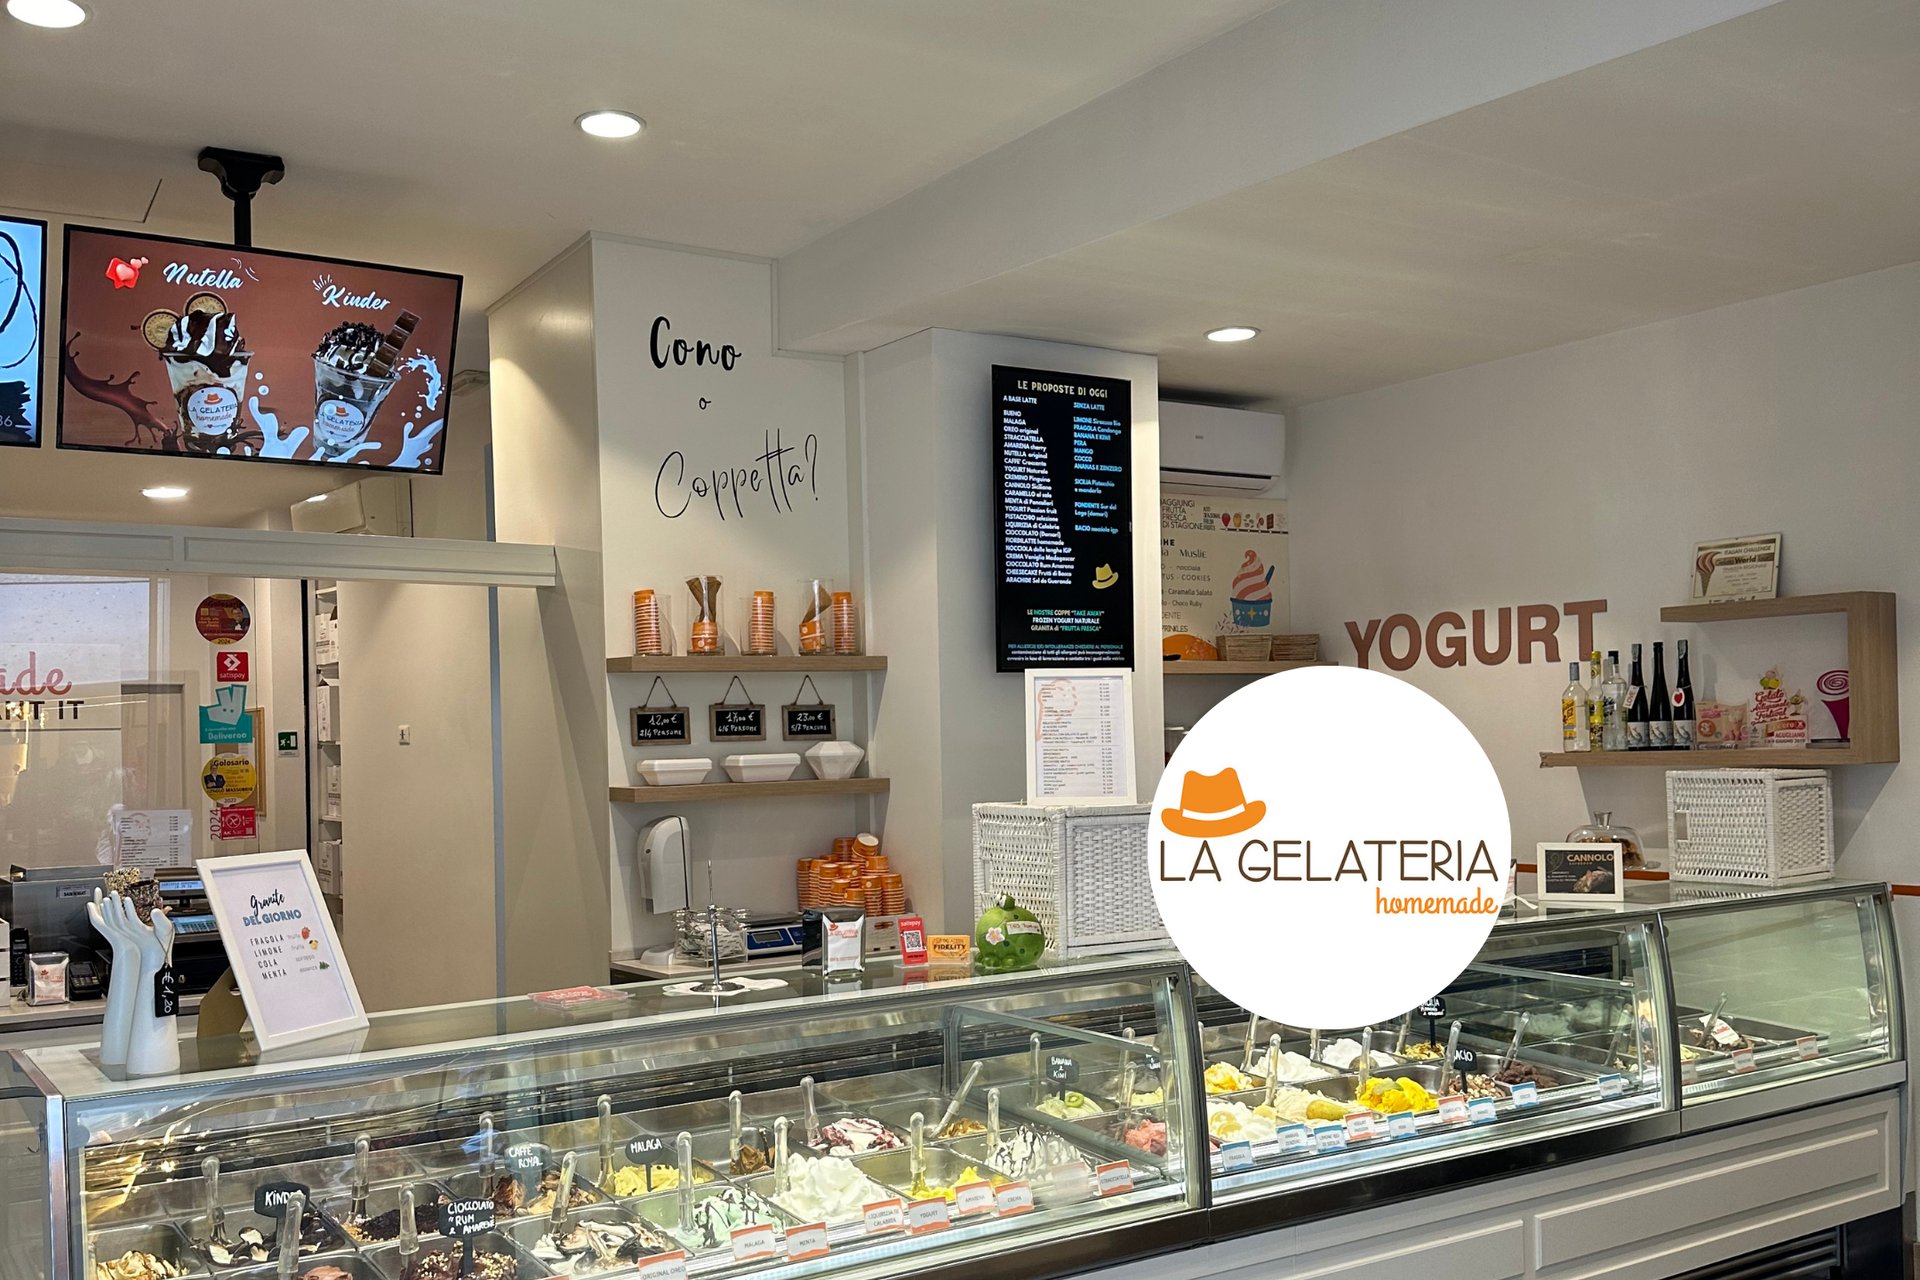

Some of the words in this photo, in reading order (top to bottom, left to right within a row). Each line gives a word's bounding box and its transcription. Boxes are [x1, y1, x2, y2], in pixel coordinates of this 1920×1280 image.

[163, 262, 244, 290] Nutella
[322, 284, 390, 310] Kinder
[650, 316, 742, 371] Cono
[1018, 380, 1028, 390] LE
[1031, 382, 1074, 394] PROPOSTE
[1078, 387, 1086, 396] DI
[1090, 388, 1108, 398] OGGI
[699, 397, 712, 410] o
[1004, 434, 1044, 443] STRACCIATELLA
[655, 428, 818, 520] Coppetta?
[1162, 506, 1186, 514] FRUTTA
[1162, 513, 1187, 521] FRESCA
[1170, 521, 1203, 530] STAGIONE
[1735, 556, 1756, 564] World
[1344, 599, 1607, 672] YOGURT
[1626, 690, 1636, 707] LOVE
[1755, 689, 1784, 701] Gelato
[670, 713, 678, 723] €
[748, 712, 755, 721] €
[817, 712, 824, 720] €
[1755, 708, 1787, 720] Festival
[208, 732, 247, 740] Deliveroo
[210, 809, 221, 840] 2024
[1567, 853, 1614, 862] CANNOLO
[250, 889, 285, 917] Granite
[243, 914, 261, 927] DEL
[262, 909, 302, 924] GIORNO
[250, 934, 284, 946] FRAGOLA
[254, 945, 283, 957] LIMONE
[258, 959, 278, 969] COLA
[261, 969, 287, 980] MENTA
[1051, 1056, 1072, 1066] BANANA
[1454, 1049, 1473, 1061] ACIO
[630, 1138, 663, 1153] MALAGA
[518, 1156, 543, 1168] ROYAL
[1101, 1174, 1131, 1184] STRACCIATELLA
[448, 1201, 494, 1214] CIOCCOLATO
[920, 1210, 938, 1218] YOGURT
[873, 1218, 897, 1226] CALABRIA
[744, 1240, 765, 1249] MALAGA
[640, 1270, 669, 1280] ORIGINAL
[670, 1266, 686, 1275] OREO
